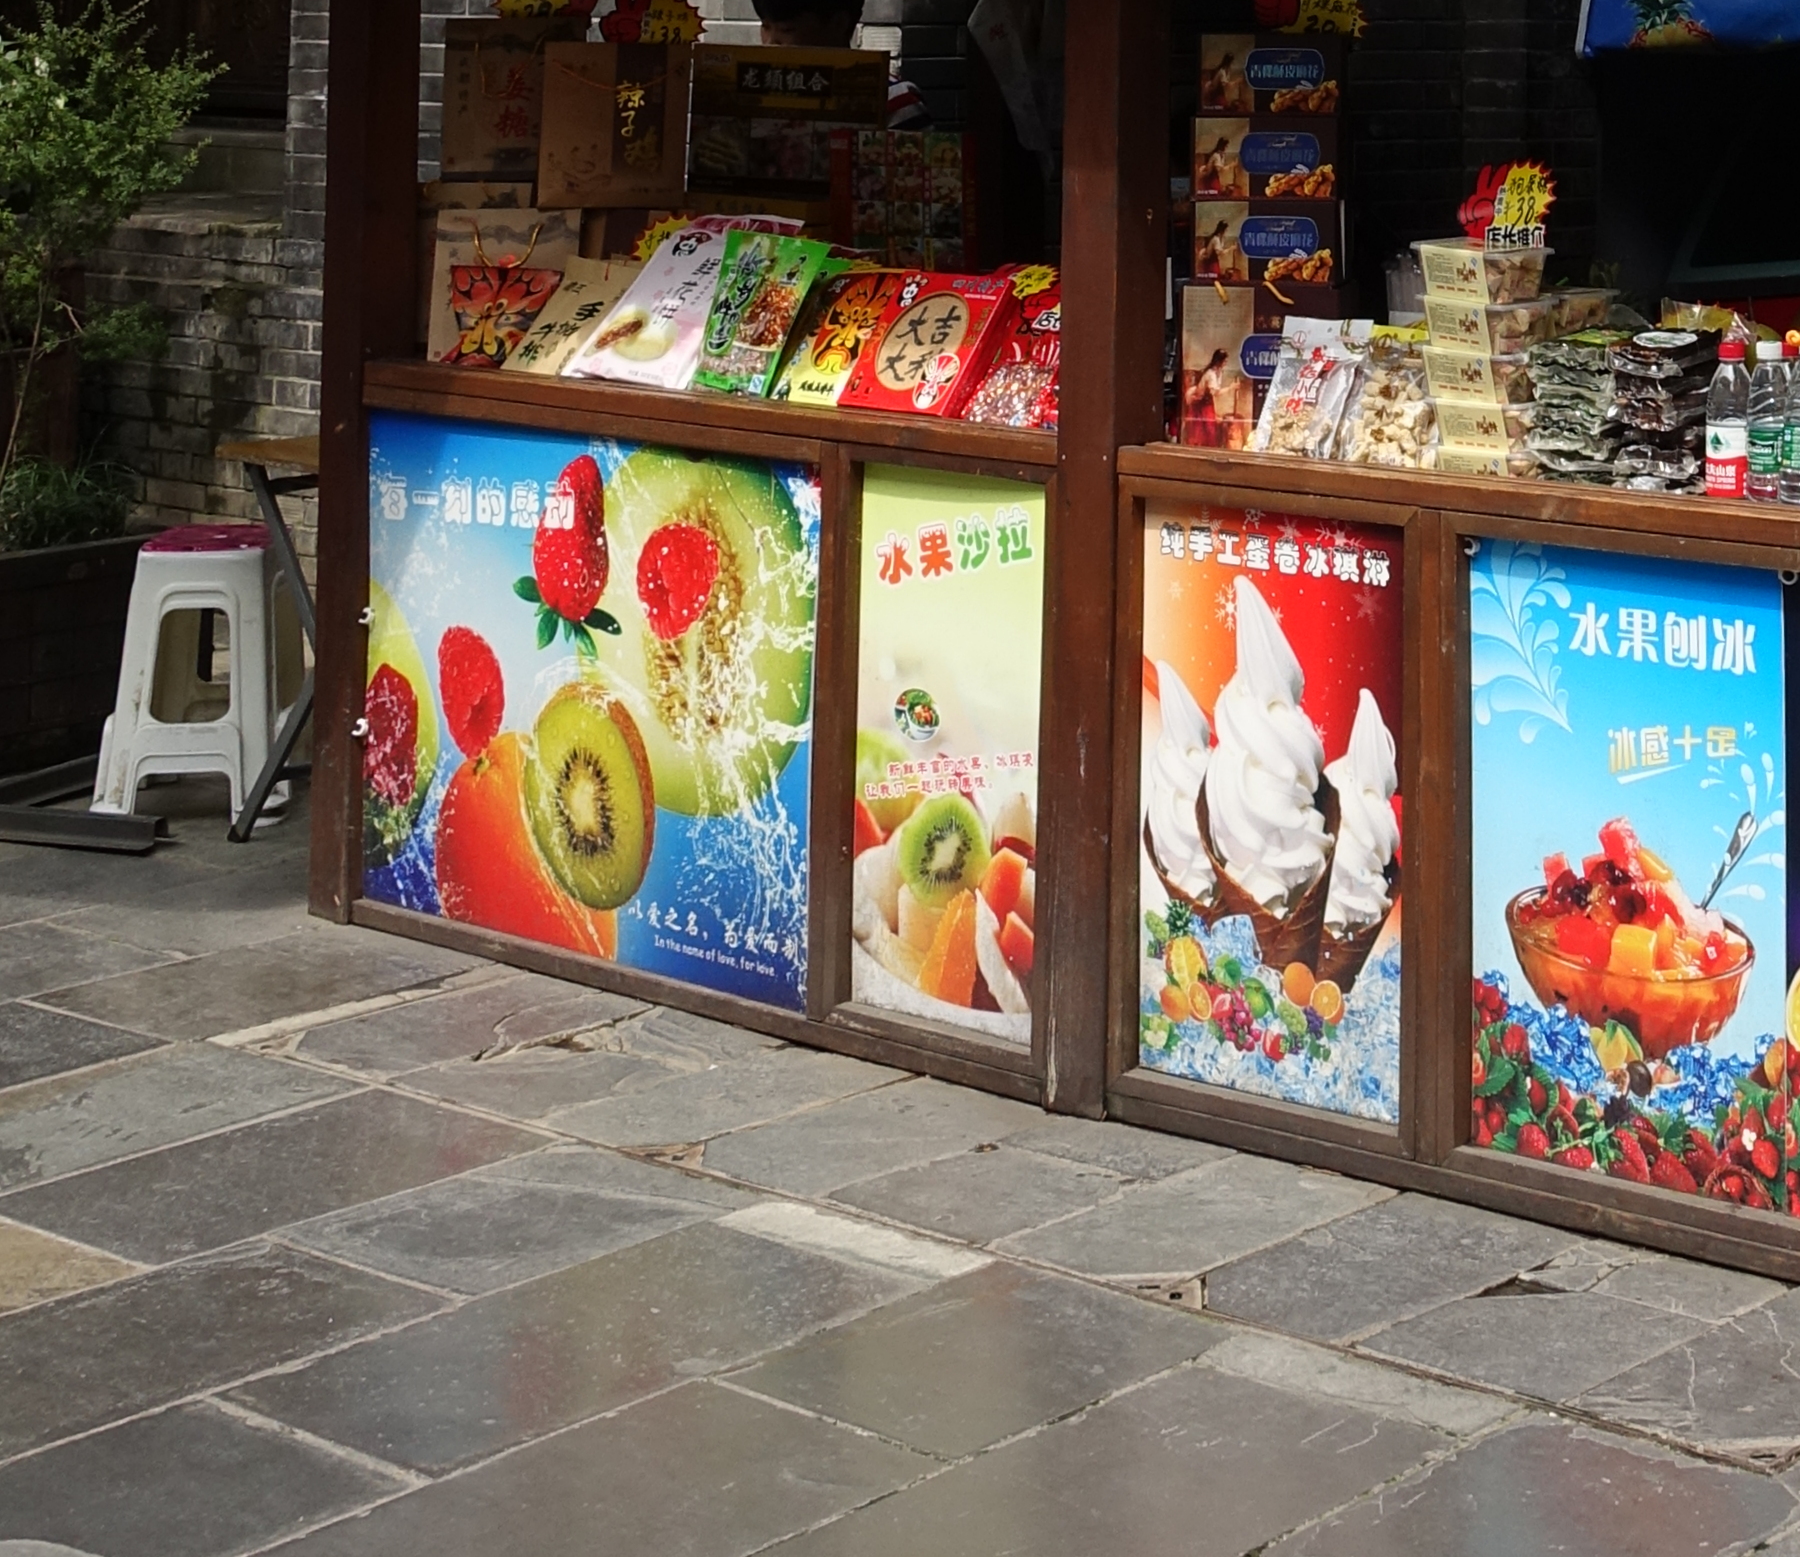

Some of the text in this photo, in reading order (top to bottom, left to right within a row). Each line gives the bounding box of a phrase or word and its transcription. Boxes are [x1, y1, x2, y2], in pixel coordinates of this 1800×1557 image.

[380, 472, 576, 530] 每一刻的感动
[876, 507, 1033, 585] 水果沙拉
[1568, 601, 1757, 675] 水果刨冰
[1608, 724, 1738, 775] 冰感十足
[654, 934, 665, 948] In
[666, 937, 681, 953] the
[705, 948, 716, 962] of
[740, 956, 755, 971] for
